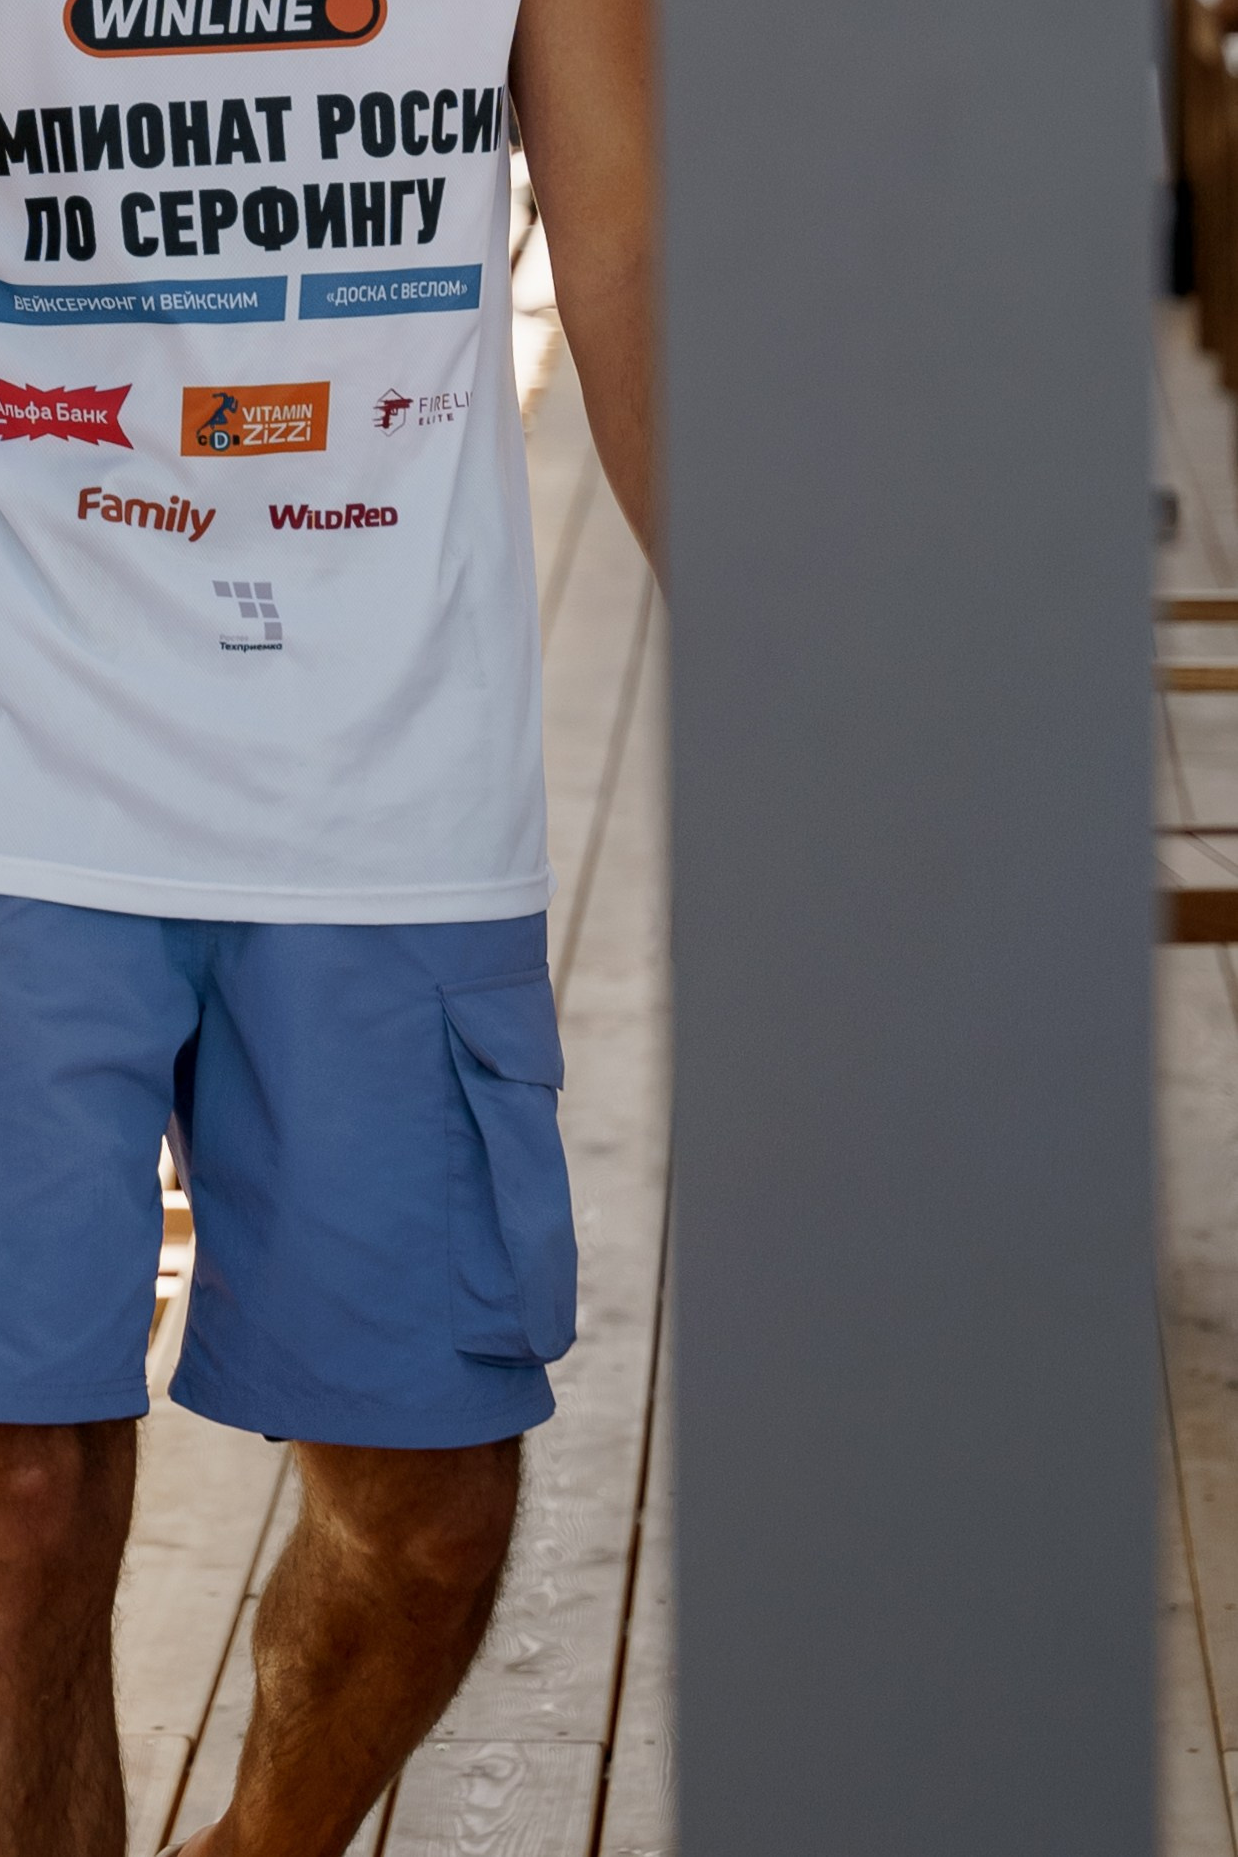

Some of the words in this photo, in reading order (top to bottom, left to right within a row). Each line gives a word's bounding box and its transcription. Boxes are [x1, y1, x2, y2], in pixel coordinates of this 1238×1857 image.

[24, 195, 97, 262] ПО
[121, 177, 446, 257] СЕРФИНГУ
[13, 294, 137, 313] ВЕЙКСЕРИФНГ
[142, 295, 156, 312] И
[160, 290, 259, 311] ВЕЙКСКИМ
[326, 284, 387, 306] «ДОСКА
[390, 283, 398, 300] С
[401, 280, 468, 299] ВЕСЛОМ»
[56, 402, 108, 424] Банк
[242, 403, 313, 422] VITAMIN
[77, 487, 216, 542] Family
[220, 642, 283, 652] Техприемка
